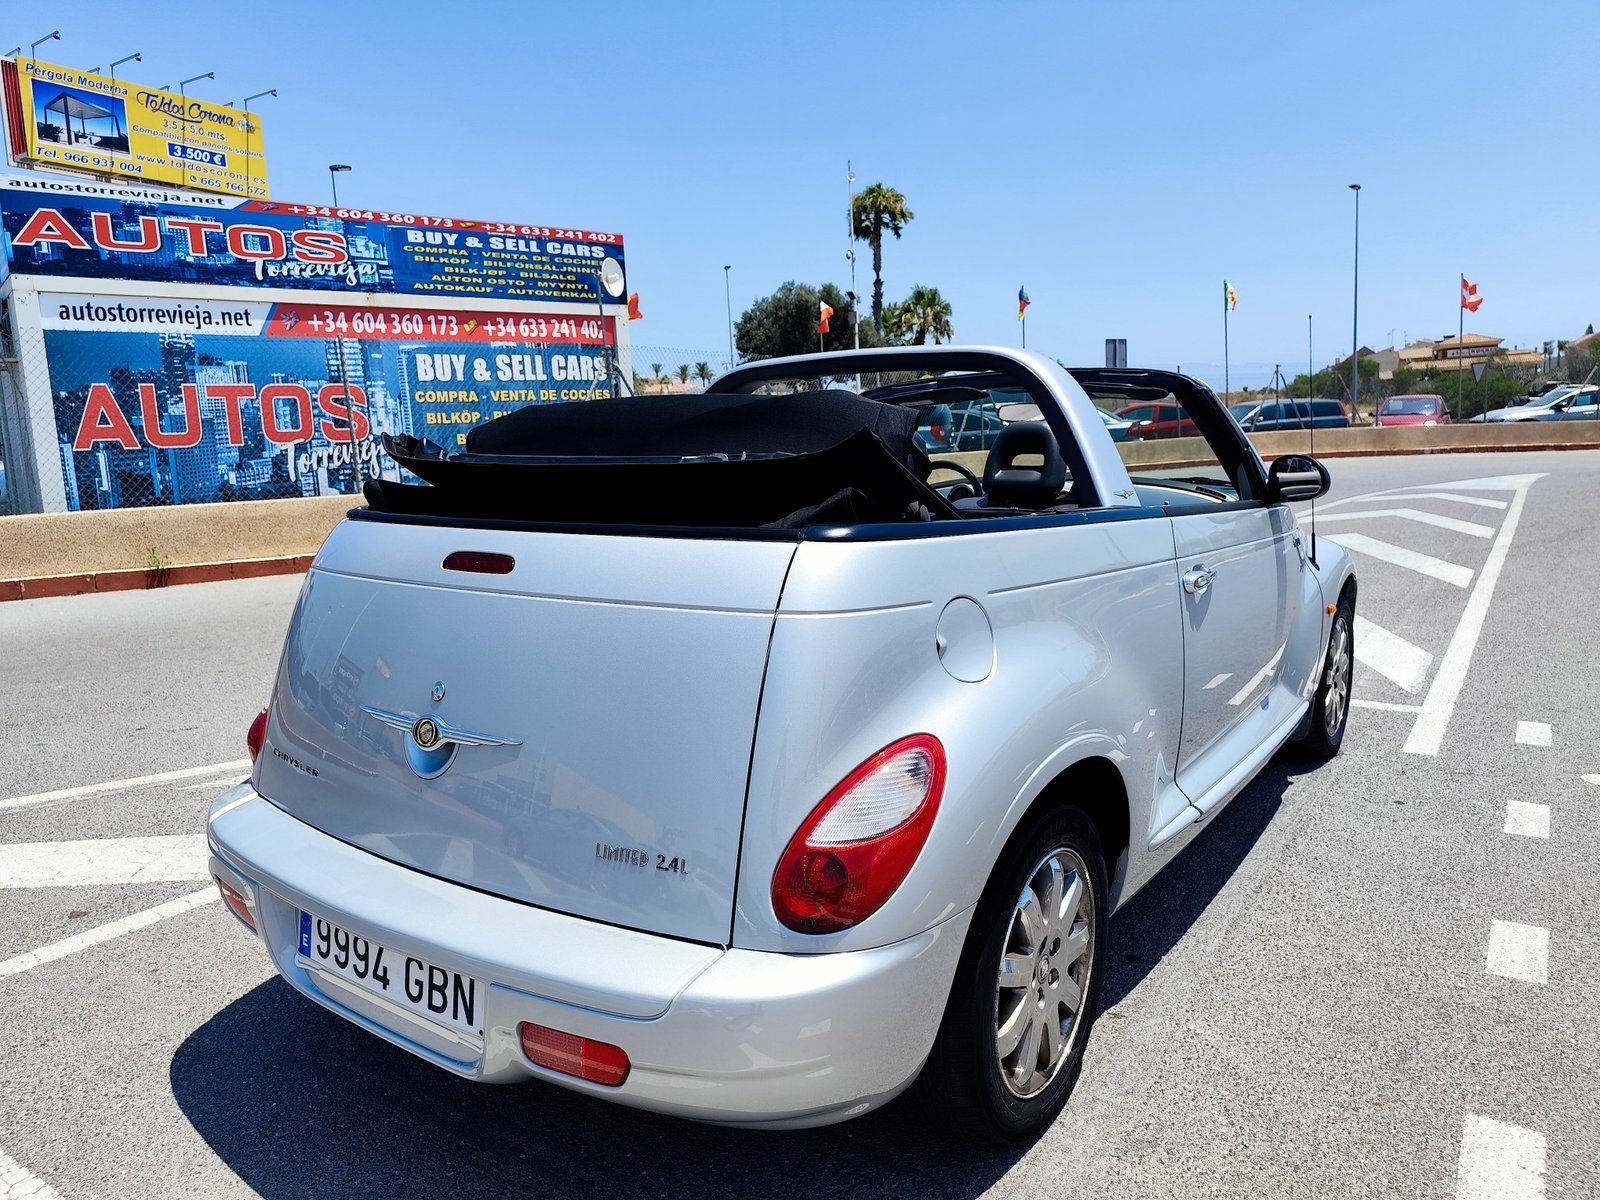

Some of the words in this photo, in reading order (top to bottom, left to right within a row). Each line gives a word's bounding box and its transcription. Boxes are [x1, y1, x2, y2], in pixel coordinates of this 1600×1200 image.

[25, 63, 74, 83] Pérgola
[77, 75, 128, 96] Moderna
[136, 91, 186, 122] Toldos
[188, 103, 235, 127] Corona
[132, 125, 182, 141] Compatible
[201, 140, 233, 152] paneles
[235, 148, 263, 158] solares
[173, 145, 210, 162] 3.500
[213, 153, 223, 165] €
[35, 146, 59, 159] Tel.
[64, 152, 89, 164] 966
[92, 157, 115, 169] 931
[119, 161, 143, 173] 004
[8, 178, 225, 207] autostorrevieja.net
[200, 177, 221, 188] 665
[225, 181, 244, 192] 166
[247, 185, 266, 196] 572
[11, 207, 348, 265] AUTOS
[287, 205, 332, 217] +34
[336, 208, 375, 221] 604
[379, 213, 415, 224] 360
[420, 216, 454, 228] 173
[481, 223, 518, 234] +34
[520, 226, 551, 236] 633
[555, 229, 583, 240] 241
[587, 232, 617, 243] 402
[403, 245, 469, 256] COMPRA
[481, 251, 528, 261] VENTA
[406, 229, 459, 246] BUY
[465, 236, 483, 248] &
[488, 236, 541, 253] SELL
[546, 242, 605, 258] CARS
[247, 259, 376, 286] Torrevieja
[414, 255, 470, 265] BILKÖP
[444, 266, 507, 276] BILKJØP
[519, 271, 577, 281] BILSALG
[413, 282, 494, 293] AUTOKAUF
[431, 274, 483, 284] AUTON
[487, 278, 525, 286] OSTO
[537, 281, 589, 290] MYYNTI
[58, 302, 252, 329] autostorrevieja.net
[308, 311, 348, 333] +34
[352, 312, 387, 334] 604
[390, 313, 424, 335] 360
[427, 315, 459, 336] 173
[483, 317, 517, 338] +34
[519, 318, 548, 338] 633
[551, 319, 578, 338] 241
[415, 353, 466, 382] BUY
[473, 357, 492, 381] &
[495, 354, 547, 382] SELL
[551, 354, 607, 381] CARS
[415, 390, 478, 403] COMPRA
[490, 390, 537, 401] VENTA
[540, 390, 557, 400] DE
[73, 382, 371, 451] AUTOS
[426, 410, 480, 425] BILKÖP
[273, 748, 319, 778] CHRYSLER
[595, 842, 649, 867] LIMITED
[656, 854, 689, 875] 2.4L
[302, 933, 309, 947] E
[316, 918, 390, 991] 9994
[405, 956, 475, 1027] GBN
